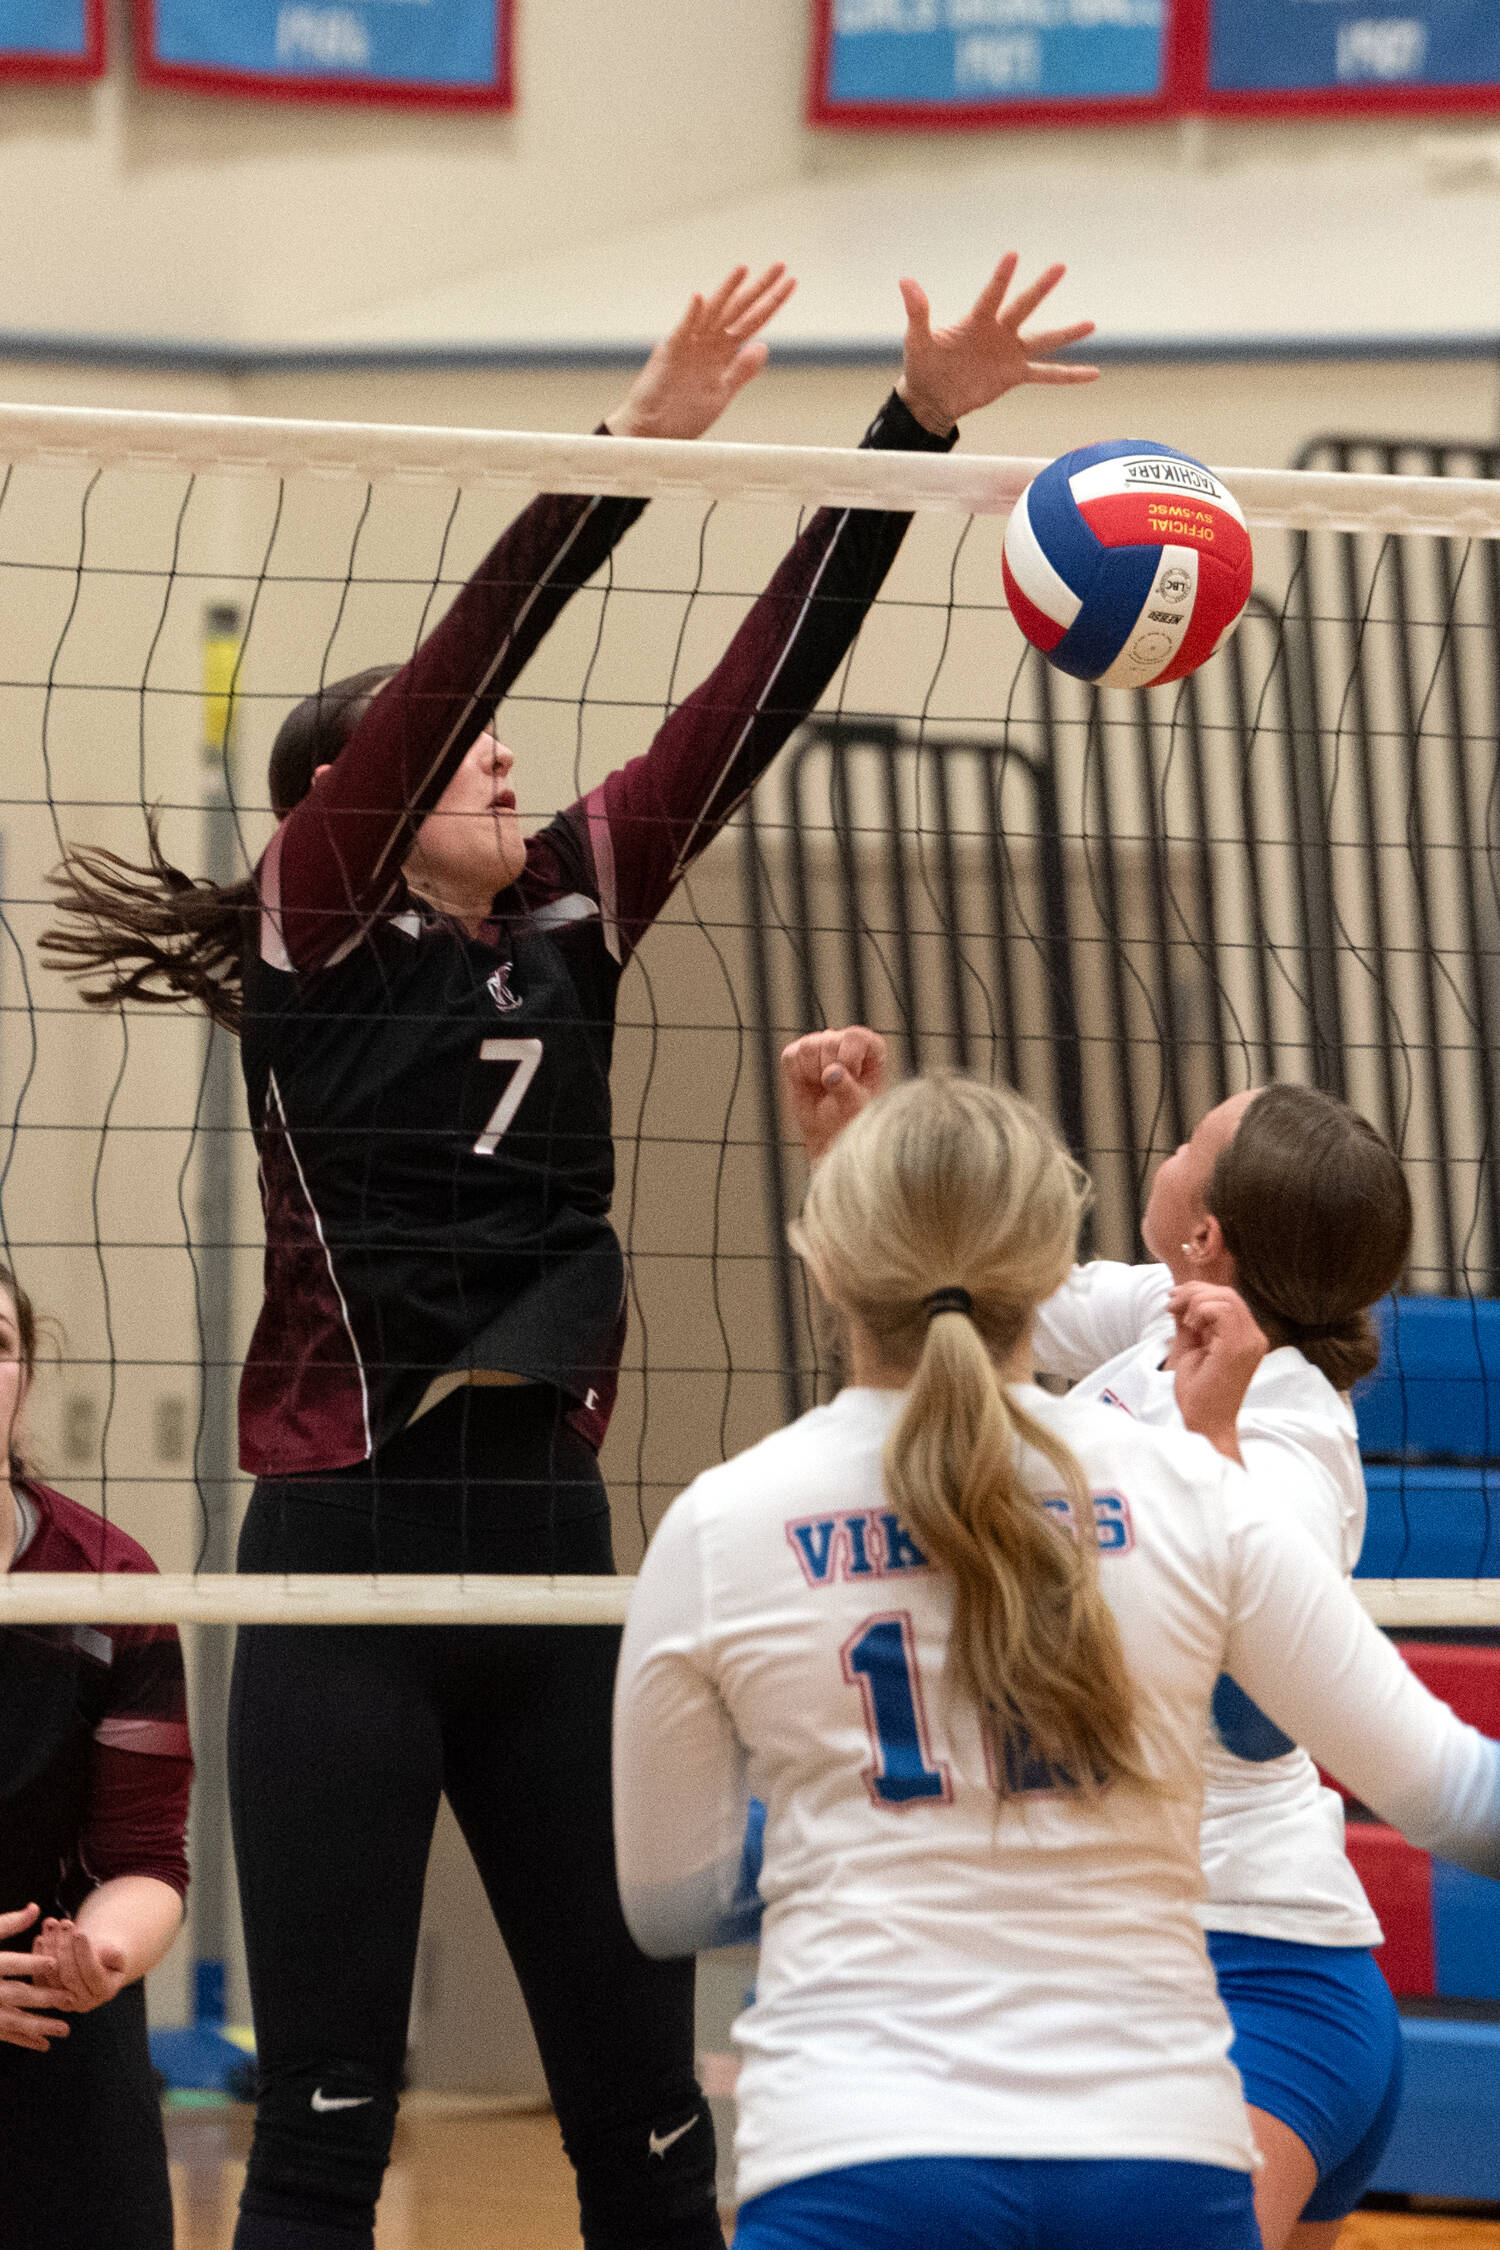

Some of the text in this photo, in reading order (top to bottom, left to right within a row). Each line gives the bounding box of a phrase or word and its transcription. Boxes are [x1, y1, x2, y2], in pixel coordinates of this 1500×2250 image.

[1127, 463, 1219, 498] TACHIKARA
[1148, 503, 1213, 524] SV-5WSC
[1147, 517, 1215, 542] OFFICIAL
[1165, 580, 1185, 592] LBC
[473, 1038, 543, 1155] 7
[785, 1488, 1136, 1588] VIKS
